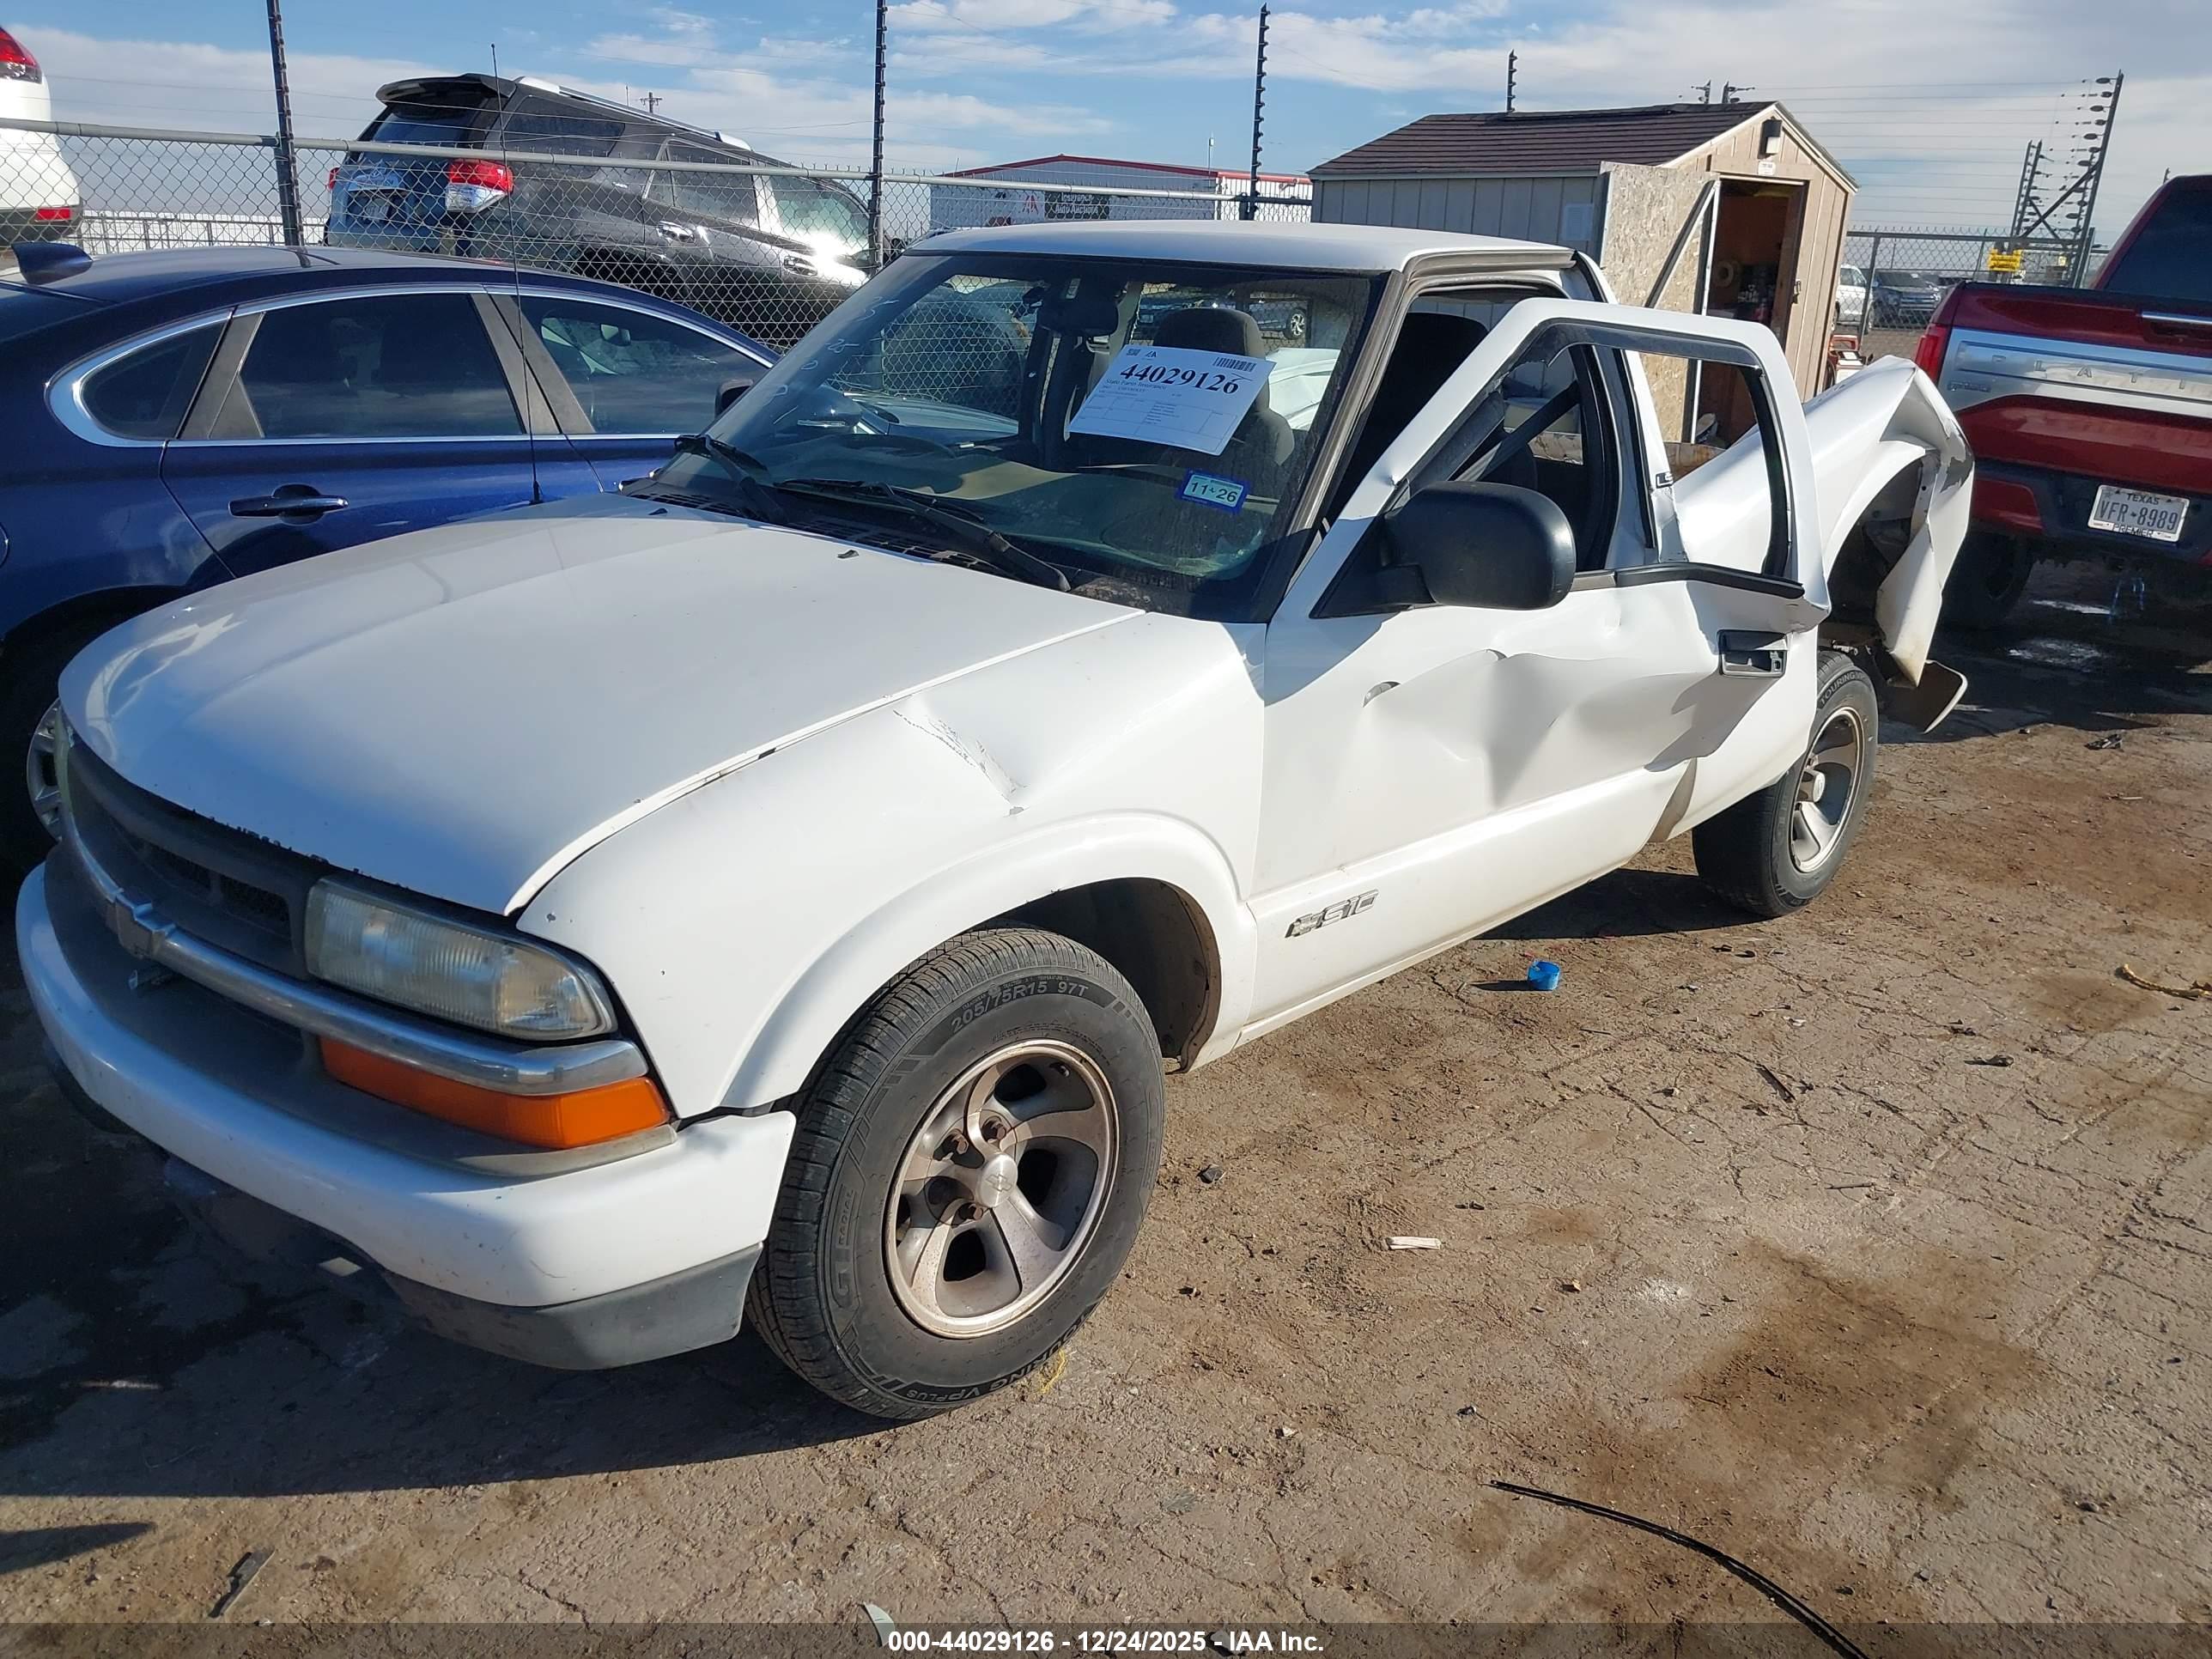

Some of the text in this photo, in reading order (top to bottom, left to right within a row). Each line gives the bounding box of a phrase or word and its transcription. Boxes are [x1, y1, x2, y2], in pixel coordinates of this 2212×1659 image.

[1120, 363, 1240, 395] 44029126
[1191, 481, 1209, 495] 11
[1215, 488, 1238, 502] 26
[2127, 493, 2161, 506] TEXAS
[2100, 501, 2179, 531] VFR 8989
[2112, 524, 2154, 538] PREMIER
[1820, 672, 1856, 705] TOURING
[951, 981, 1048, 1032] 205/75R15
[1057, 981, 1089, 1001] 97T
